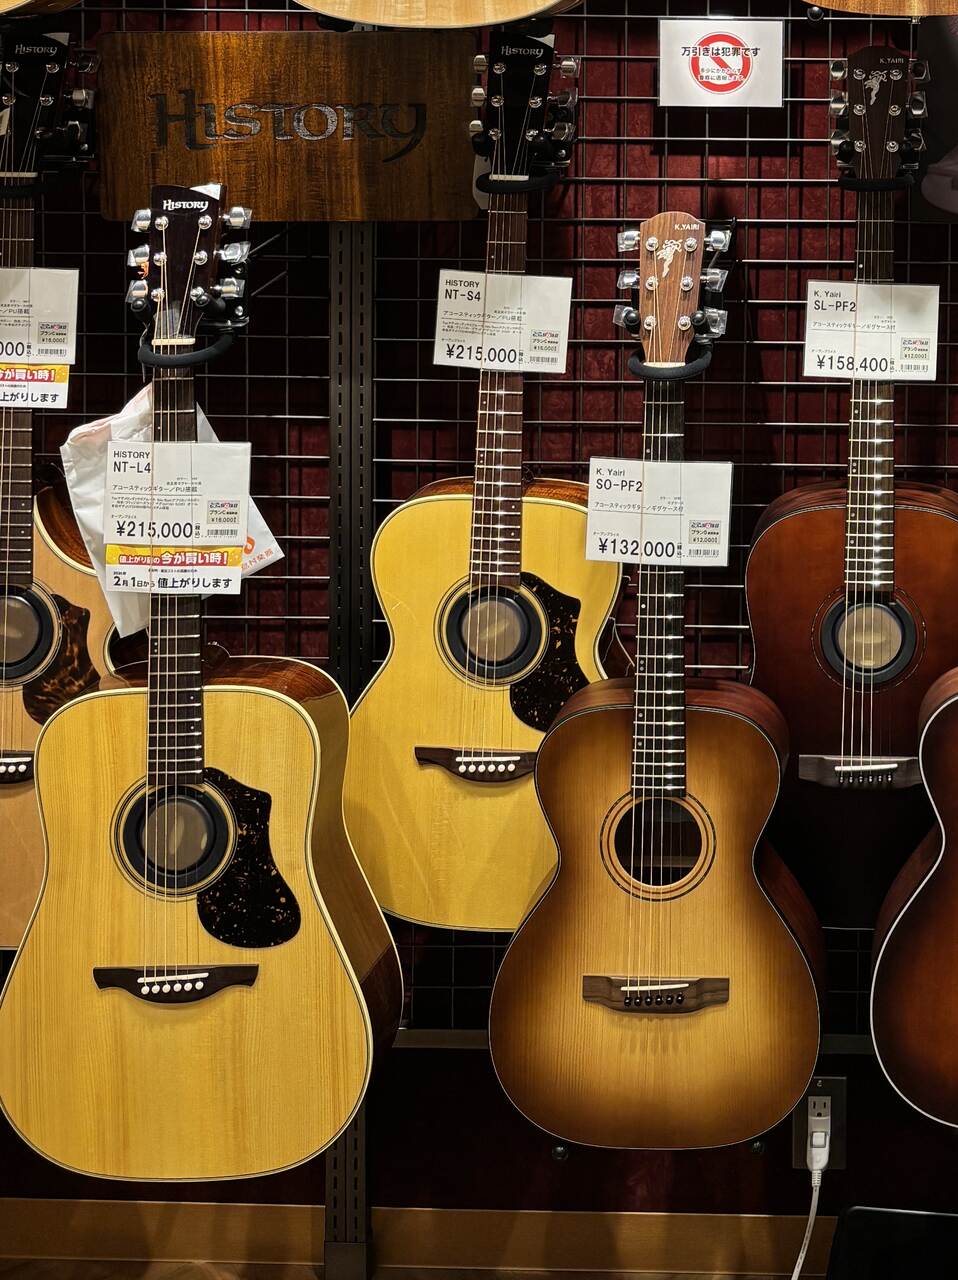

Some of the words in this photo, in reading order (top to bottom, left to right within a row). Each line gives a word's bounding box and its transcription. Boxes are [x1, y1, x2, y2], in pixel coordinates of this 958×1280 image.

[681, 46, 760, 57] 万引きは犯罪です
[445, 279, 480, 288] HISTORY
[445, 288, 480, 302] NT-S4
[814, 300, 856, 312] SL-PF2
[446, 343, 517, 363] ¥215,000
[817, 355, 888, 372] ¥158,400
[113, 451, 150, 459] HISTORY
[113, 461, 151, 473] NT-L4
[607, 469, 625, 477] Yairi
[596, 478, 643, 492] SO-PF2
[116, 520, 193, 538] ¥215,000
[598, 538, 675, 557] ¥132,000
